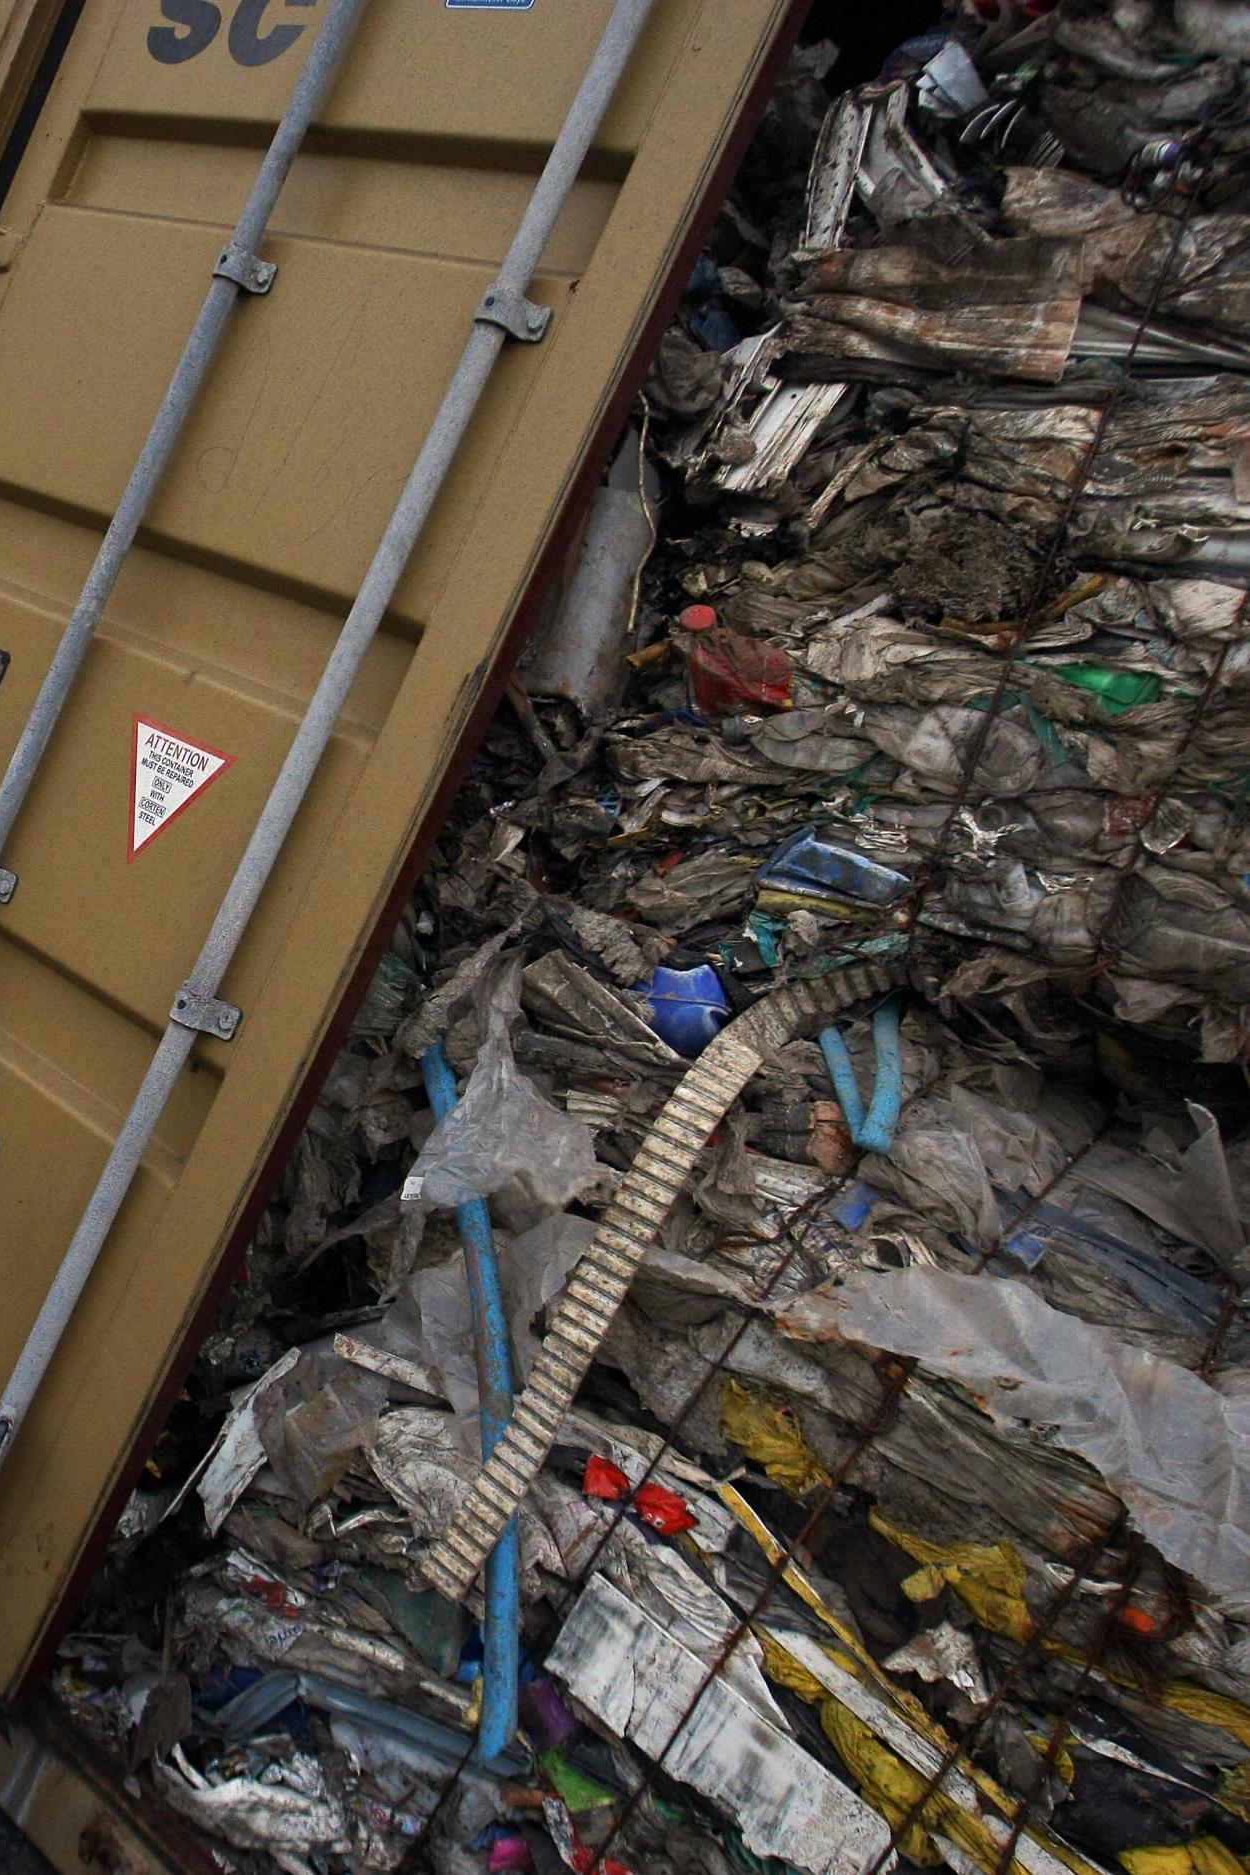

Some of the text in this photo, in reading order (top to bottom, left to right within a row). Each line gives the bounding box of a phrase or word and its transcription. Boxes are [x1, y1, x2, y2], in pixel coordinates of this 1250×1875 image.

[145, 733, 209, 772] ATTENTION
[149, 750, 194, 778] THIS CONTAINER
[141, 758, 194, 789] MUST BE REPAIRED
[154, 778, 171, 792] ONLY
[149, 790, 165, 802] WITH
[141, 799, 165, 816] CORTEN
[138, 811, 156, 826] STEEL
